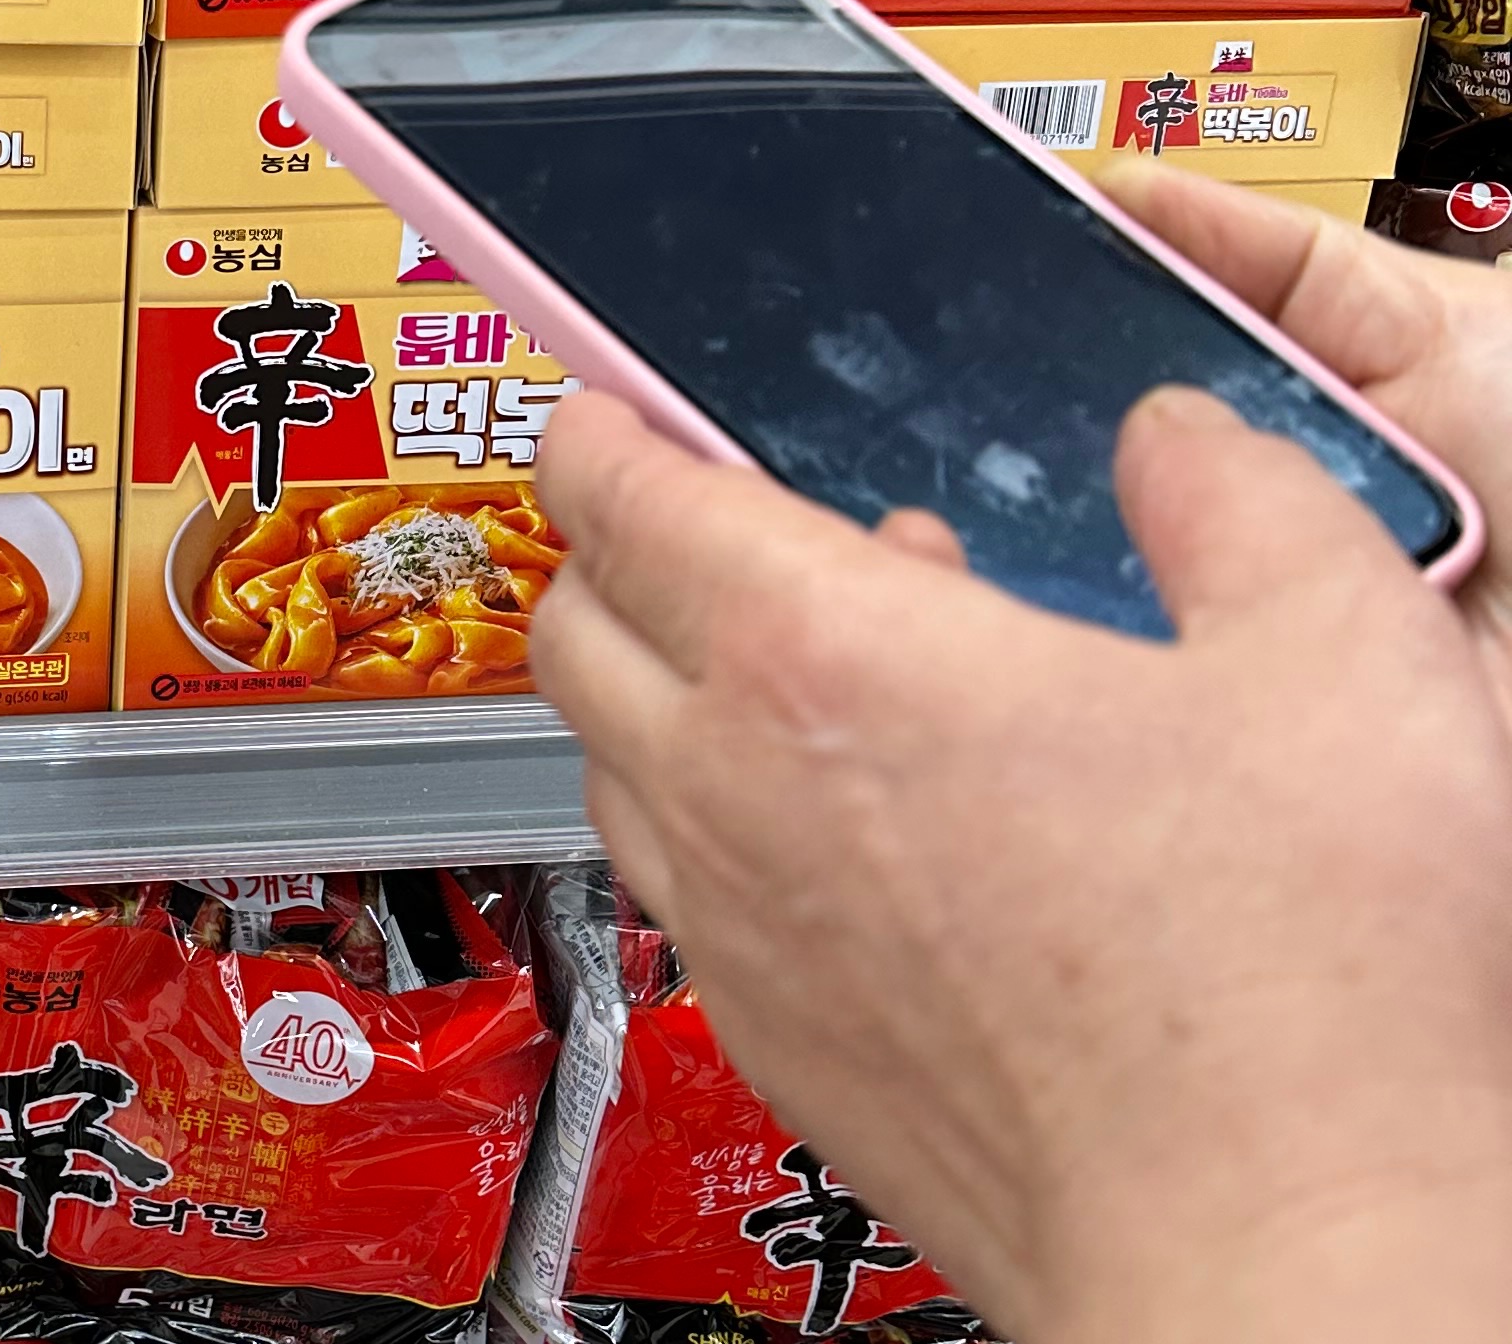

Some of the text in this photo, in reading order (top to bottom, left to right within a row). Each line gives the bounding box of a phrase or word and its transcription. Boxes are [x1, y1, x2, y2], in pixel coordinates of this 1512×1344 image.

[1137, 72, 1197, 158] 辛
[260, 153, 310, 174] 농심
[213, 228, 283, 240] 인생을 맛있게
[211, 244, 282, 273] 농심
[396, 314, 514, 365] 툼바
[197, 281, 375, 513] 辛
[42, 690, 68, 702] kcal)
[2, 983, 83, 1015] 농심
[260, 1013, 349, 1081] 40
[267, 1070, 339, 1088] ANNIVERSARY
[130, 1197, 269, 1240] 라면
